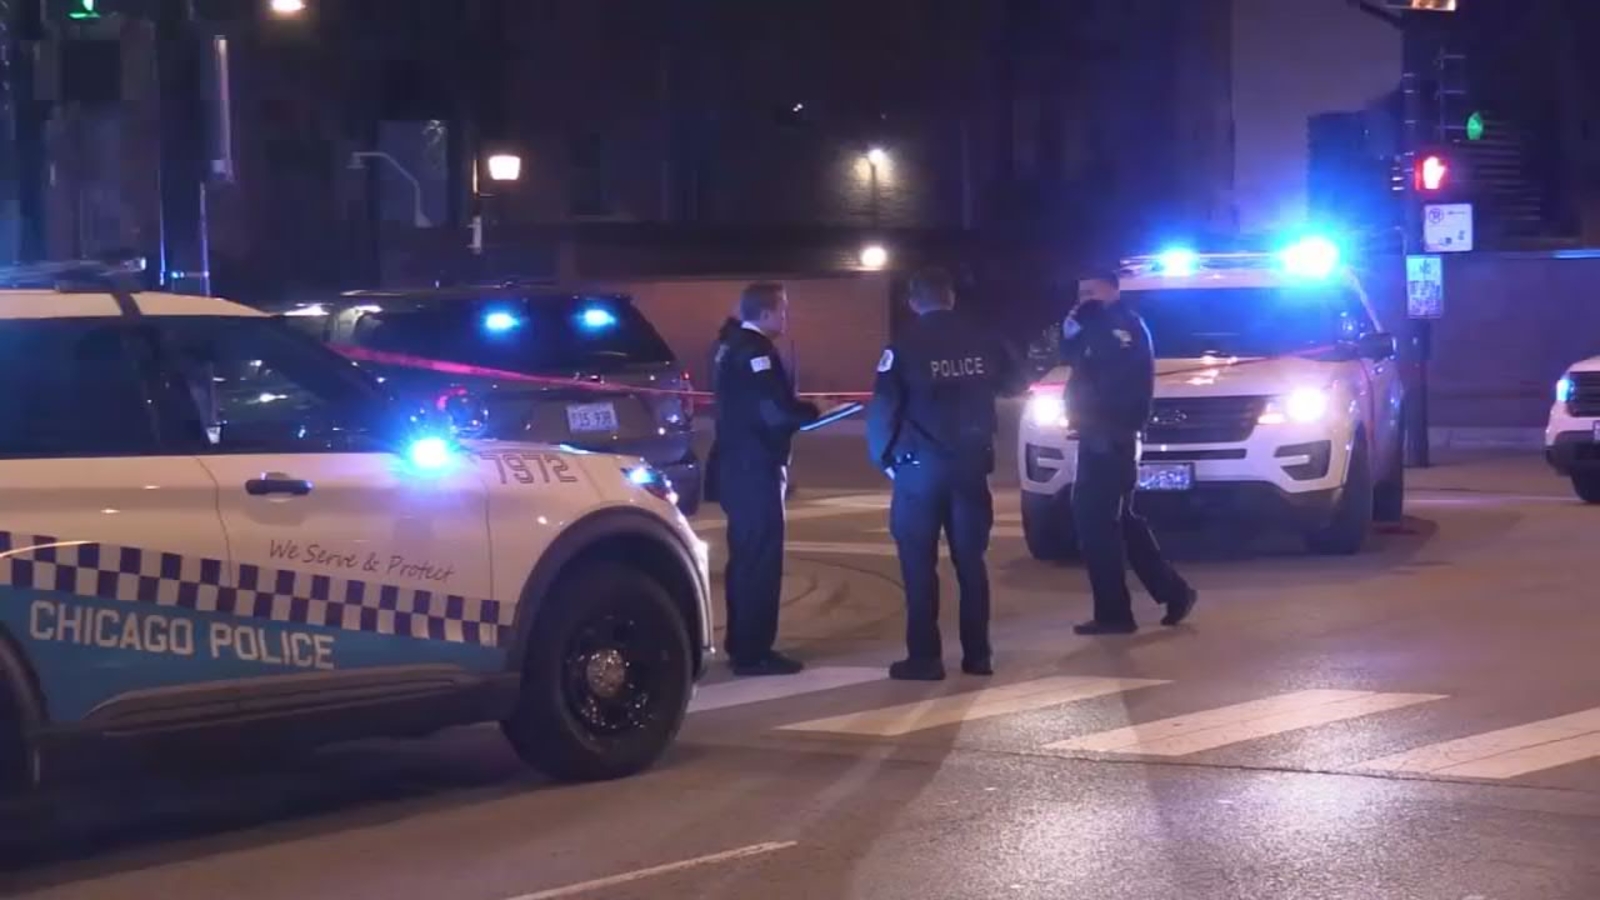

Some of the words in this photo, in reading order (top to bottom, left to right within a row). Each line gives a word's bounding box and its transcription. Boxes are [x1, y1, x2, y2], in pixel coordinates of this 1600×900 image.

[930, 356, 985, 378] POLICE
[482, 454, 578, 484] 7972
[269, 539, 299, 560] We
[305, 544, 358, 568] Serve
[362, 552, 381, 572] &
[386, 554, 455, 583] Protect
[29, 600, 194, 656] CHICAGO
[209, 622, 335, 670] POLICE
